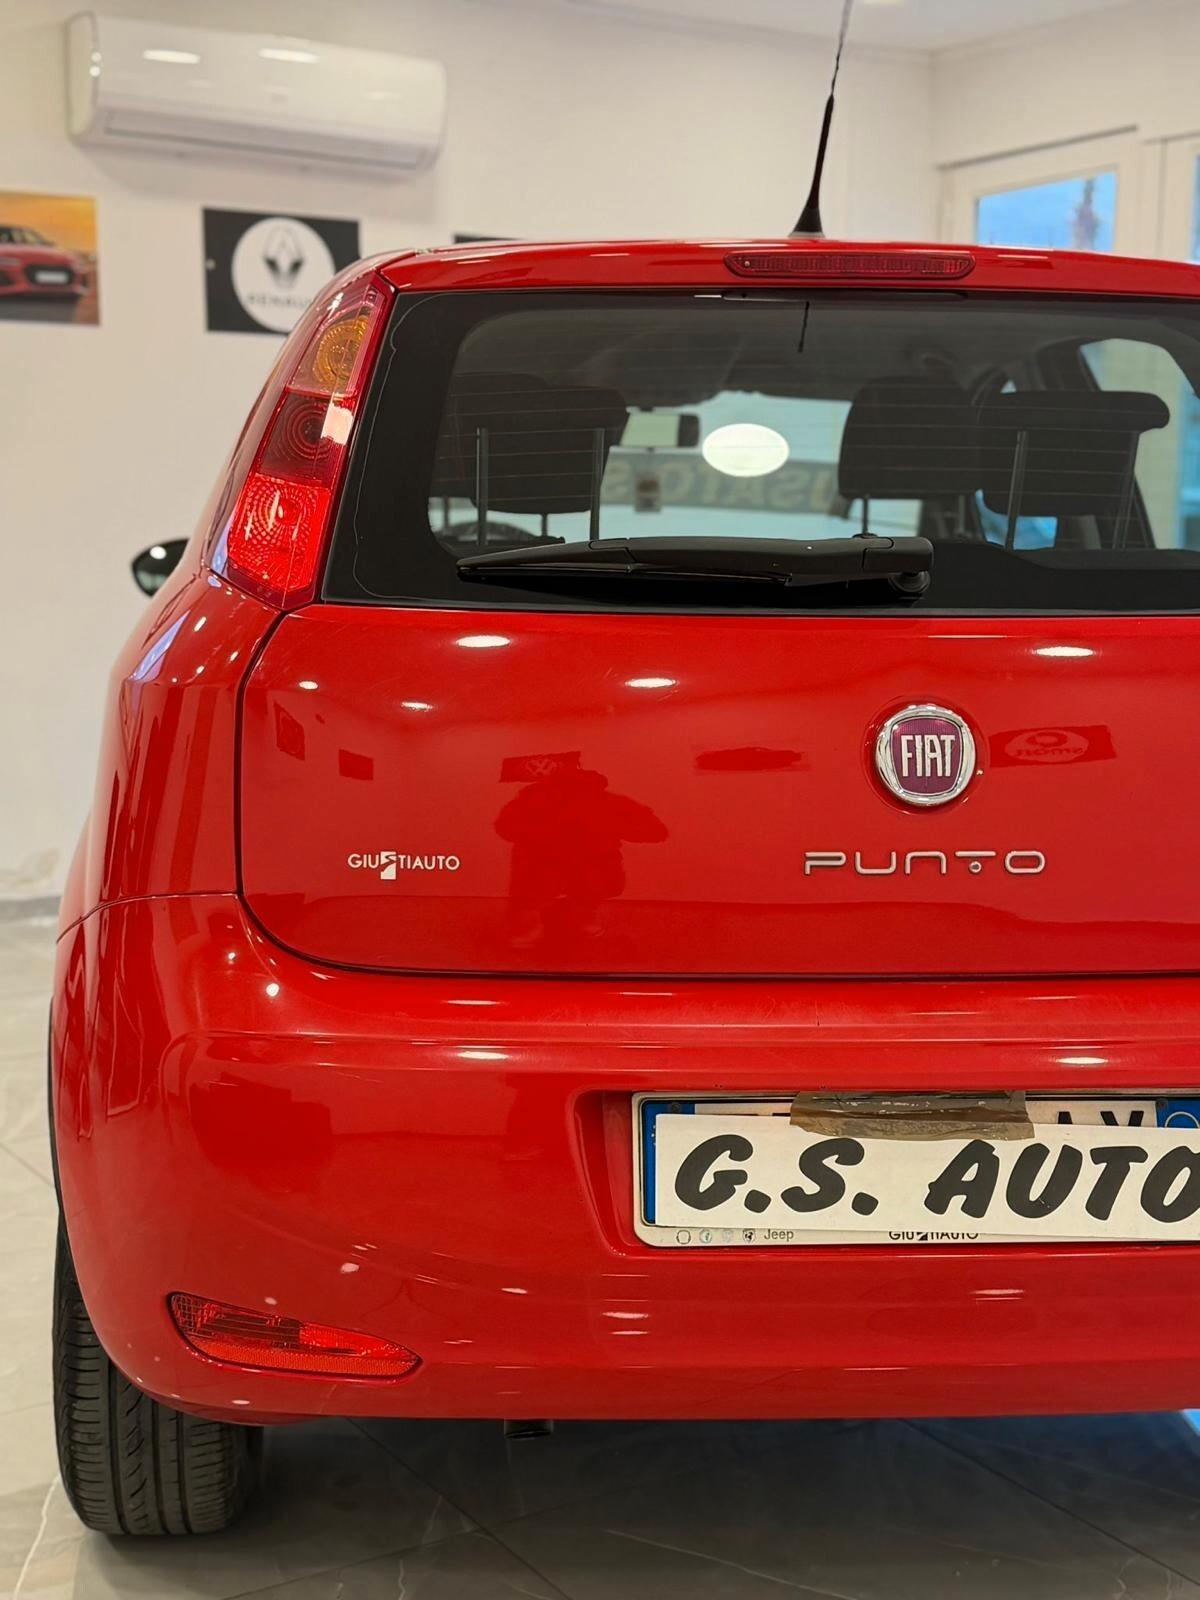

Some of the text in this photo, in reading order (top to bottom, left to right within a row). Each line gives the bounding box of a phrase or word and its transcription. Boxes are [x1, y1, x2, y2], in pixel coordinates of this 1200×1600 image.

[901, 735, 955, 777] FIAT
[347, 851, 460, 880] GIUSTIAUTO
[805, 851, 1046, 875] PUNTO
[675, 1134, 1200, 1223] G.S. AUTO
[764, 1229, 794, 1242] Jeep
